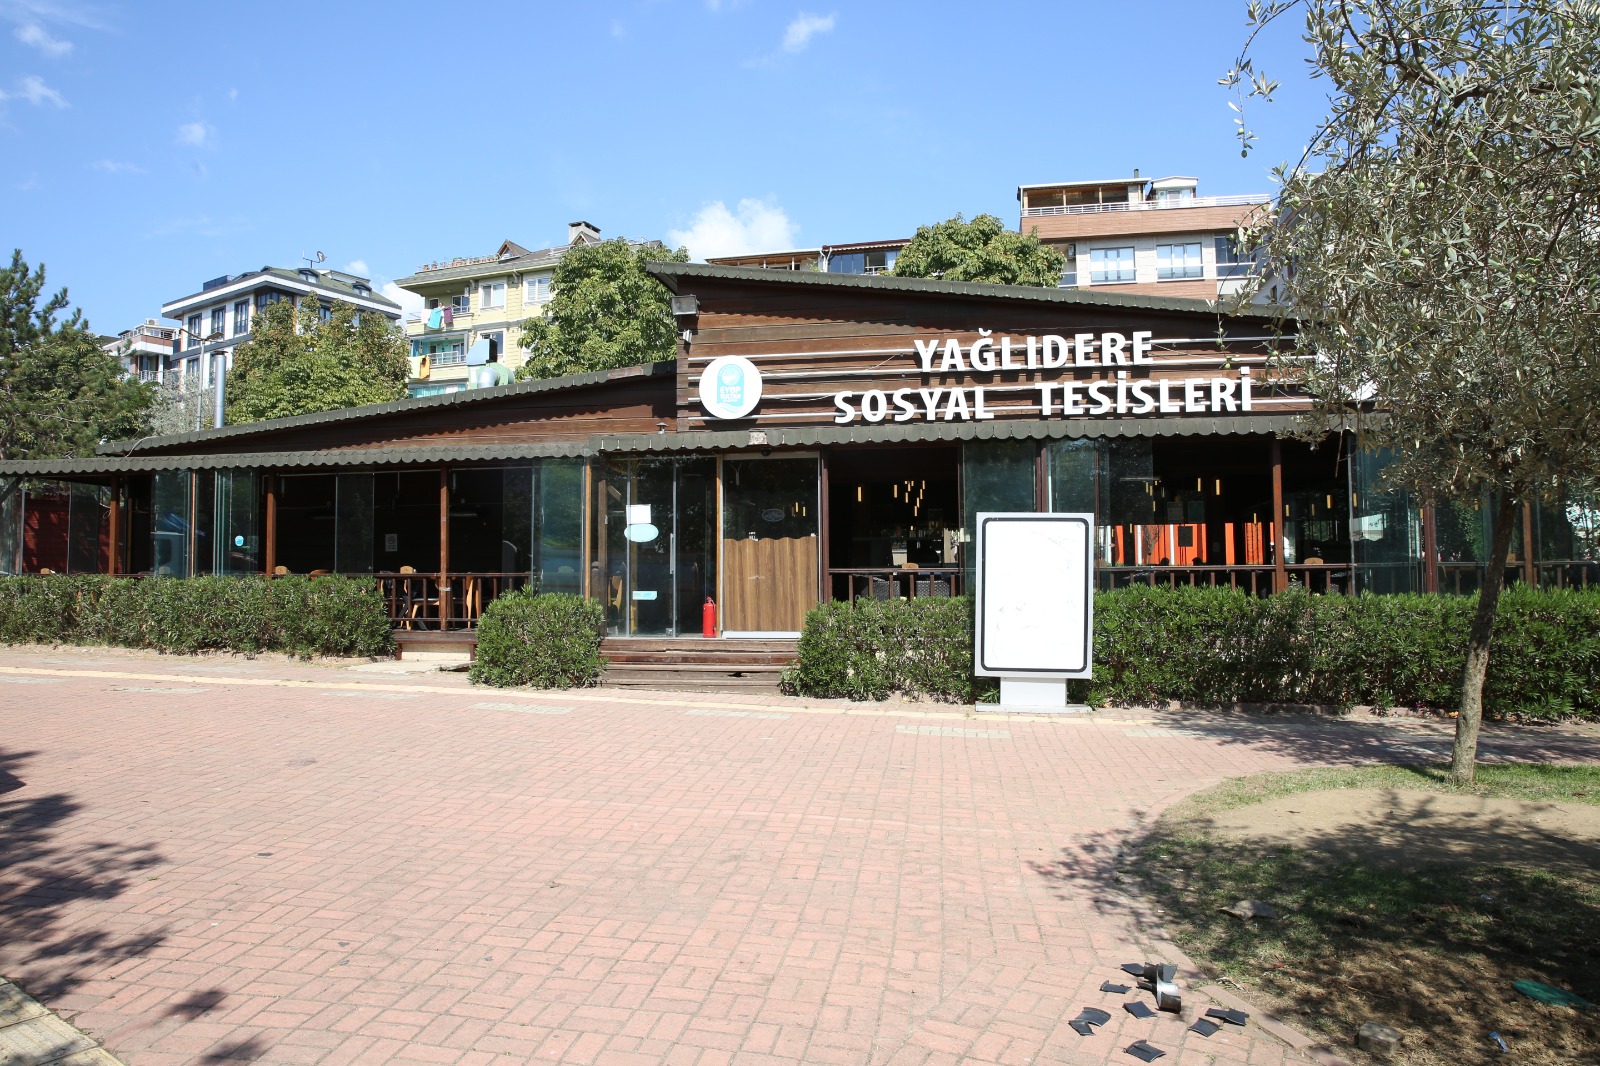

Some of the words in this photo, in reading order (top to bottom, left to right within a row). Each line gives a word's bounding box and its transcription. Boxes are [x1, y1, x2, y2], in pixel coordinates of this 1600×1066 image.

[914, 328, 1153, 372] YAĞLIDERE
[834, 386, 994, 423] SOSYAL
[1035, 366, 1251, 415] TESİSLERİ
